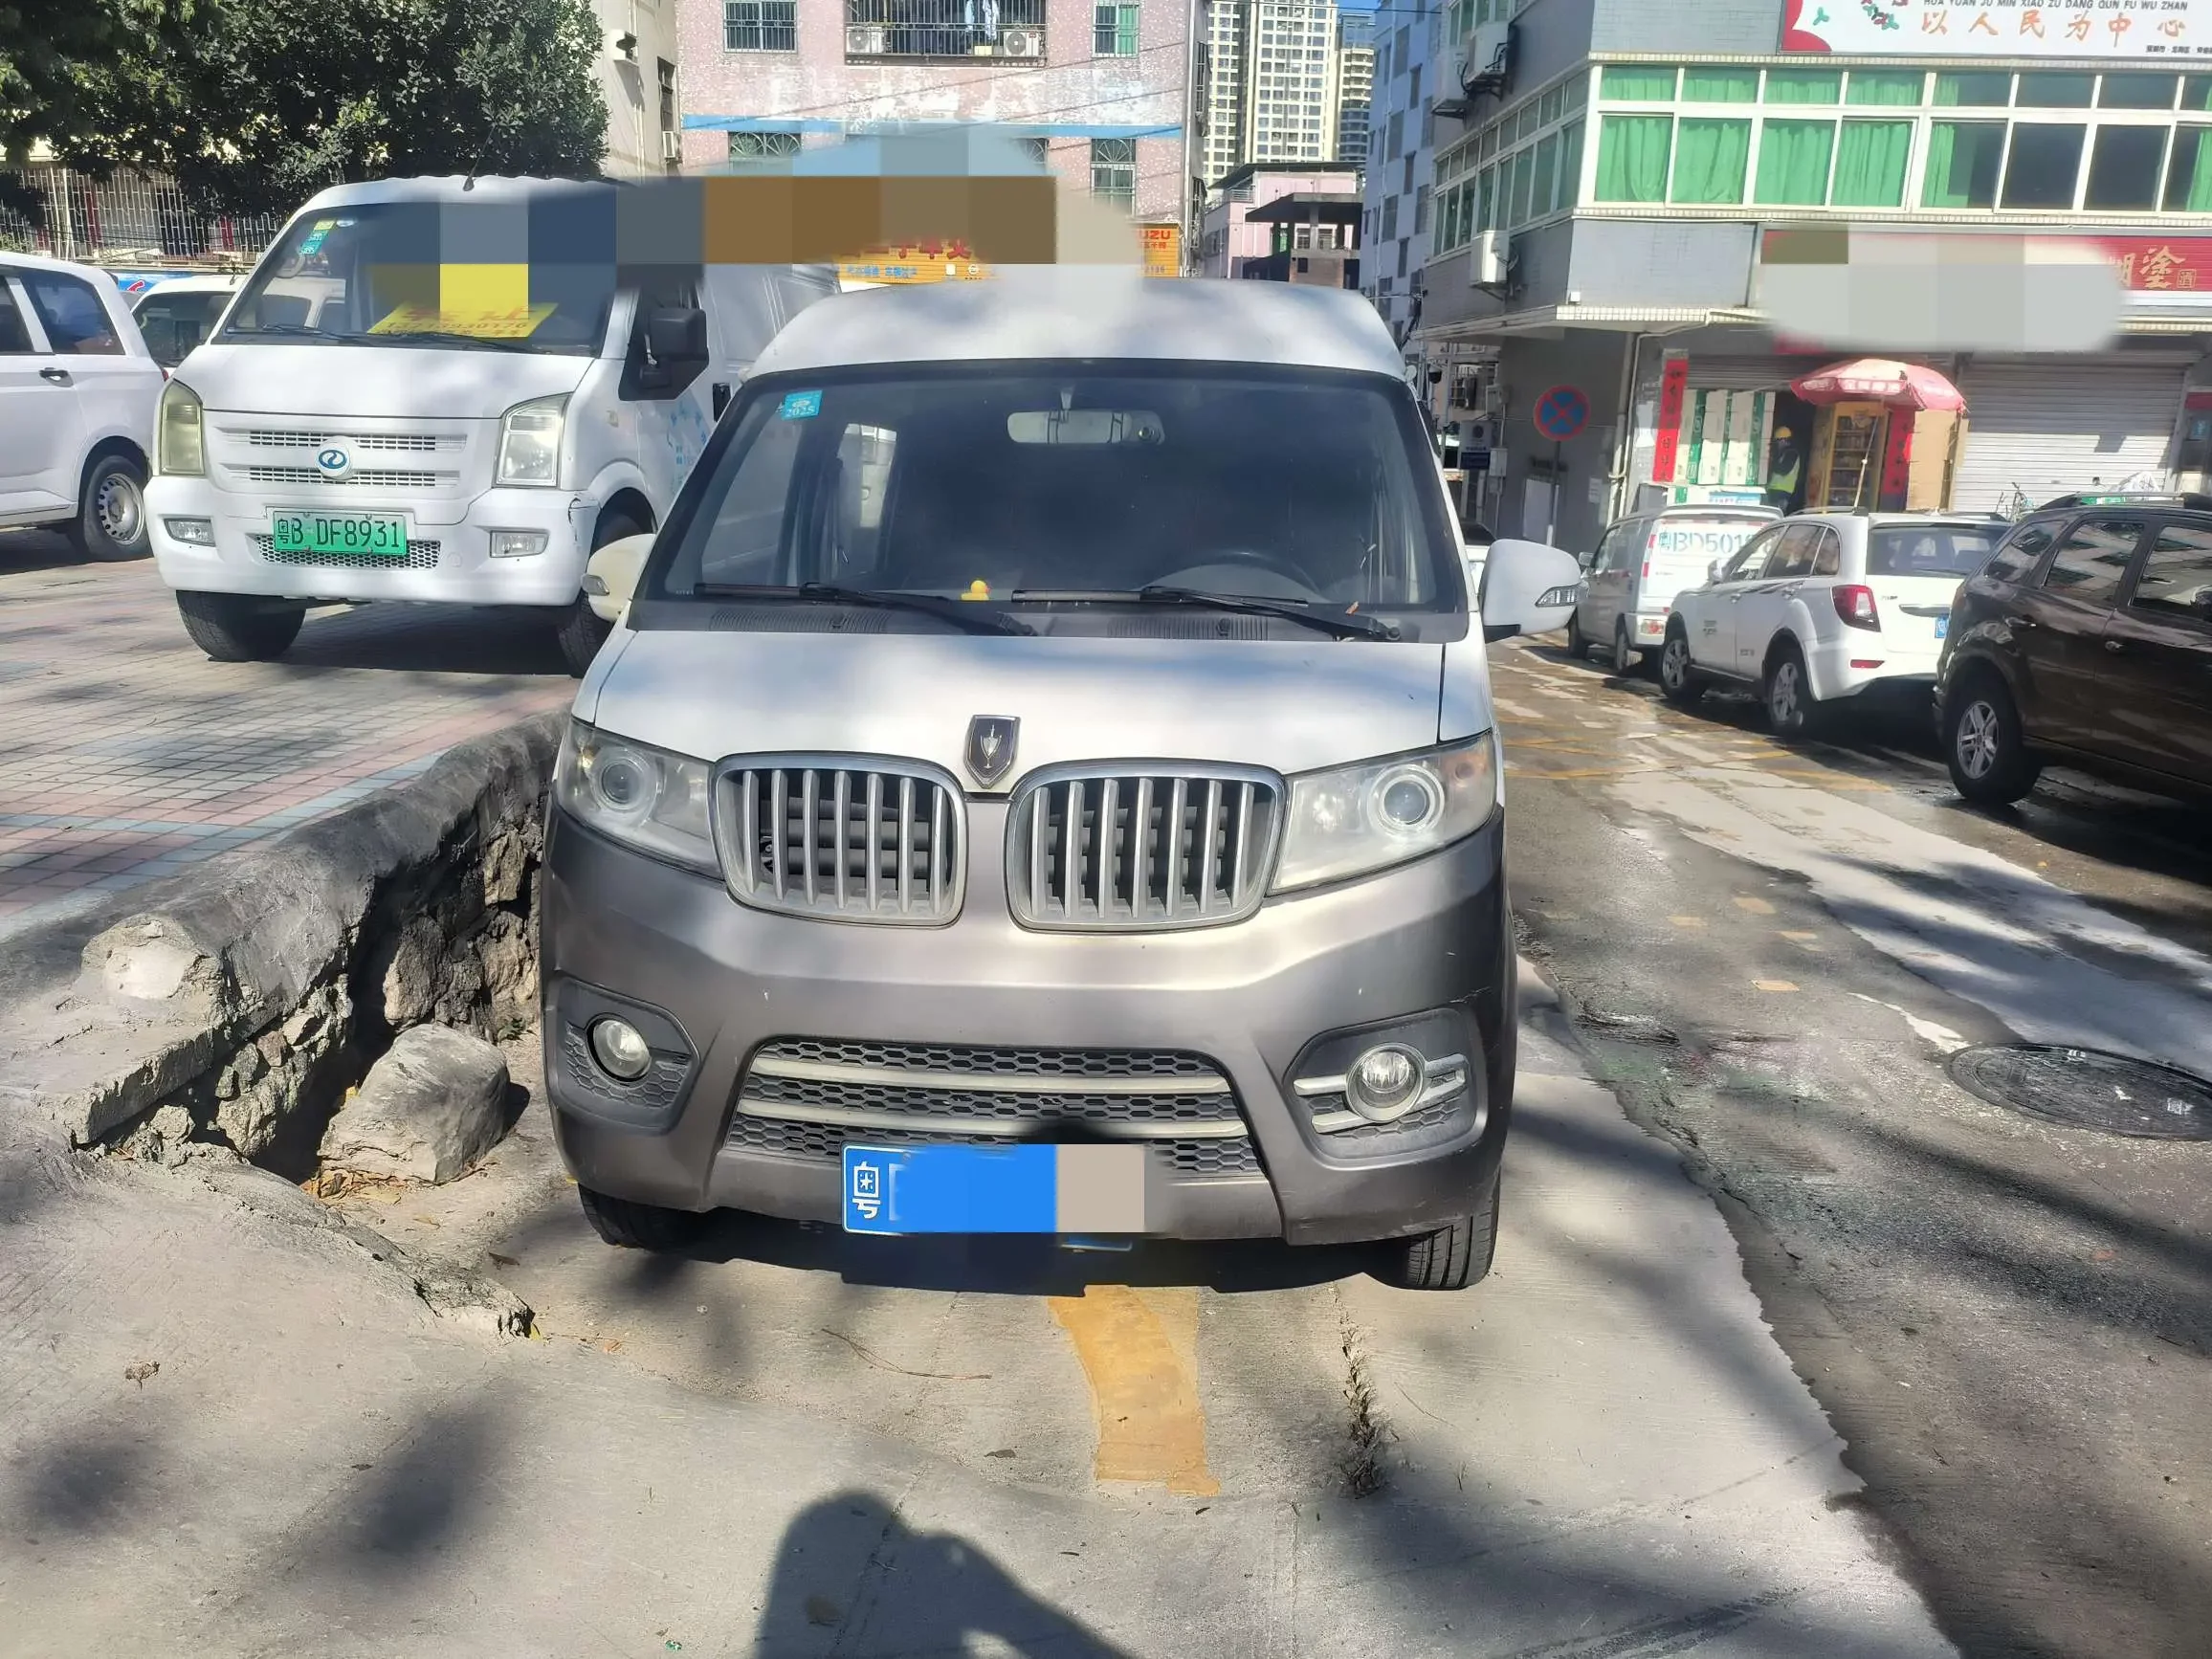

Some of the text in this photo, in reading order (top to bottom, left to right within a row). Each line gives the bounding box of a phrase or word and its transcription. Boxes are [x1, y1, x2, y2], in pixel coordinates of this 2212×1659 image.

[2065, 0, 2093, 9] DANG
[2123, 1, 2137, 10] FU
[2140, 1, 2157, 10] WU
[2160, 1, 2188, 11] ZHAN
[1921, 9, 2186, 48] 以人民为中心
